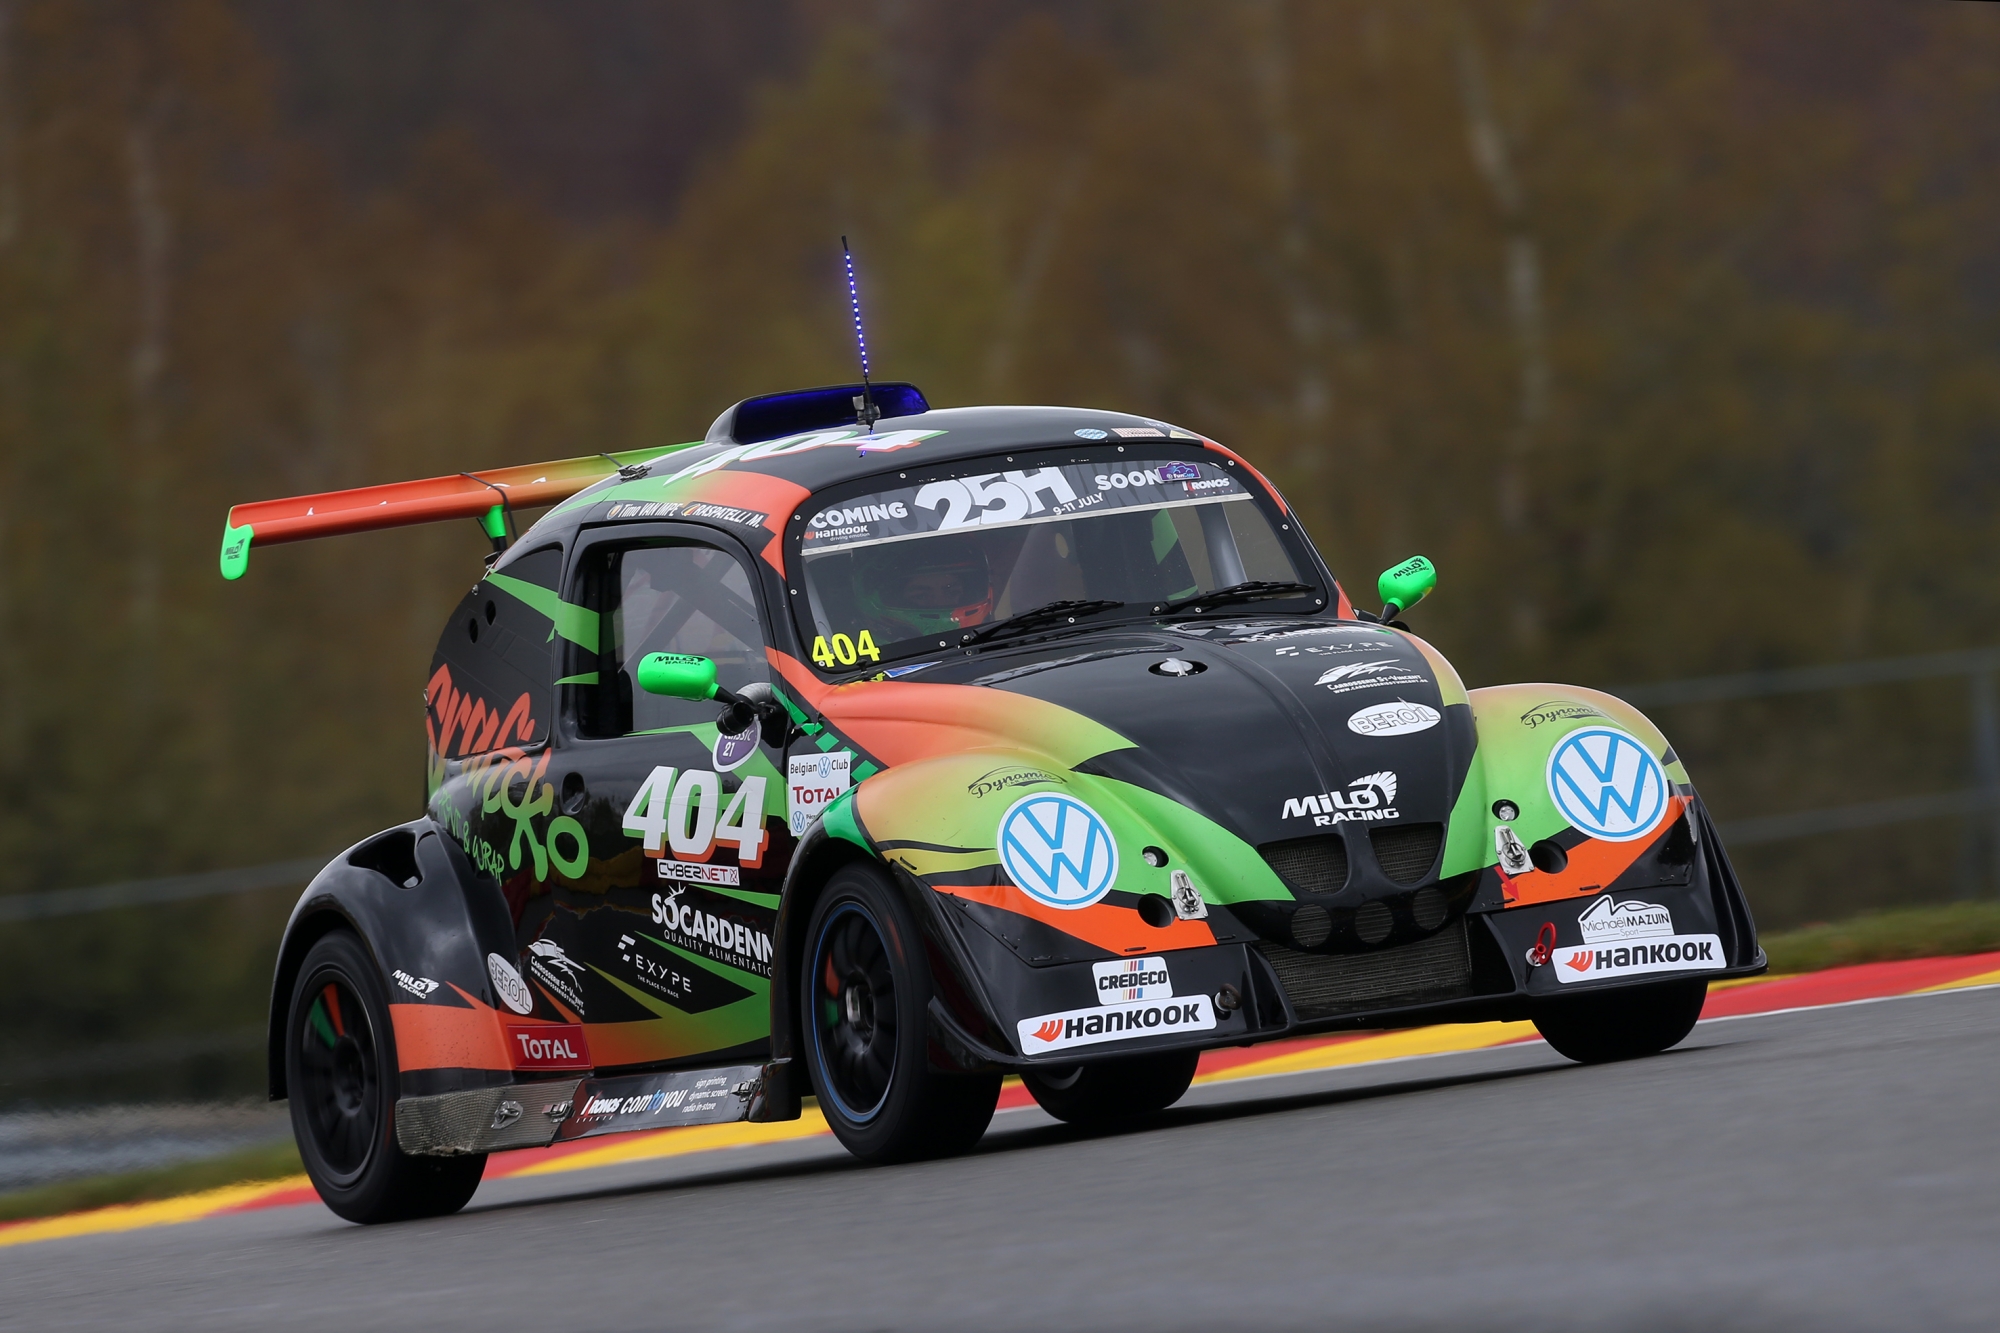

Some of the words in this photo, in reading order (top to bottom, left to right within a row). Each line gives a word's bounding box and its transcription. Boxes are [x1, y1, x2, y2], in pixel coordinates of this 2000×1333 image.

[808, 501, 908, 529] COMING
[914, 466, 1077, 530] 25H
[1095, 468, 1163, 491] SOON
[1053, 500, 1076, 516] 9-11
[1077, 492, 1104, 509] JULY
[812, 629, 880, 668] 404
[1350, 707, 1441, 734] BEROIL
[724, 729, 754, 742] SSIC
[722, 741, 735, 757] 21
[790, 762, 817, 776] Belgian
[831, 758, 849, 771] Club
[622, 765, 768, 866] 404
[1313, 807, 1400, 827] RACING
[463, 820, 470, 855] &
[664, 929, 703, 952] QUALITY
[1620, 929, 1639, 938] Sport
[488, 957, 532, 1013] BEROIL
[635, 953, 692, 993] EXYPE
[1099, 970, 1167, 990] CREDECO
[397, 981, 427, 1000] RACING
[517, 1034, 577, 1059] TOTAL
[695, 1078, 707, 1089] sign
[620, 1088, 688, 1115] comtoyou
